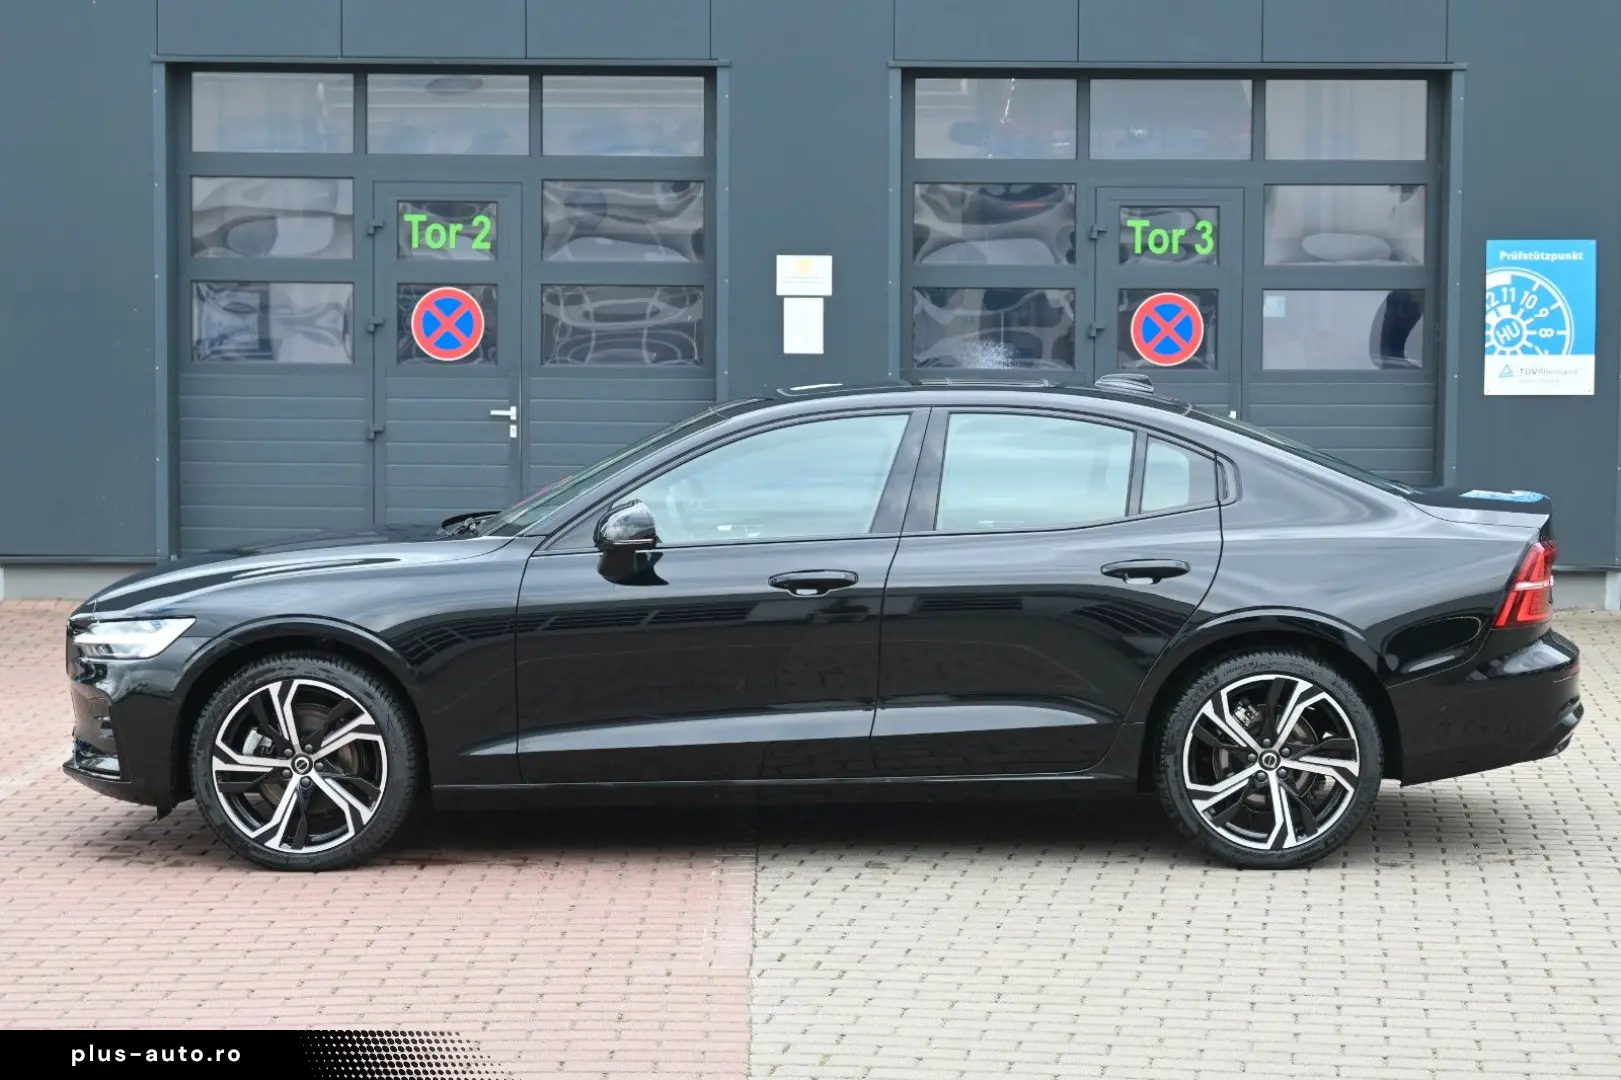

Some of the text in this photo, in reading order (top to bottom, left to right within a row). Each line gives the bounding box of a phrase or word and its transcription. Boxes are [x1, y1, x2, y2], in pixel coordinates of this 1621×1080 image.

[403, 214, 491, 249] Tor 2
[1126, 219, 1214, 255] Tor 3
[1499, 251, 1584, 262] Prüfstützpunkt
[1501, 287, 1516, 303] 11
[1520, 290, 1538, 310] 10
[1534, 307, 1550, 318] 9
[1496, 321, 1521, 345] HU
[1538, 327, 1555, 338] 8
